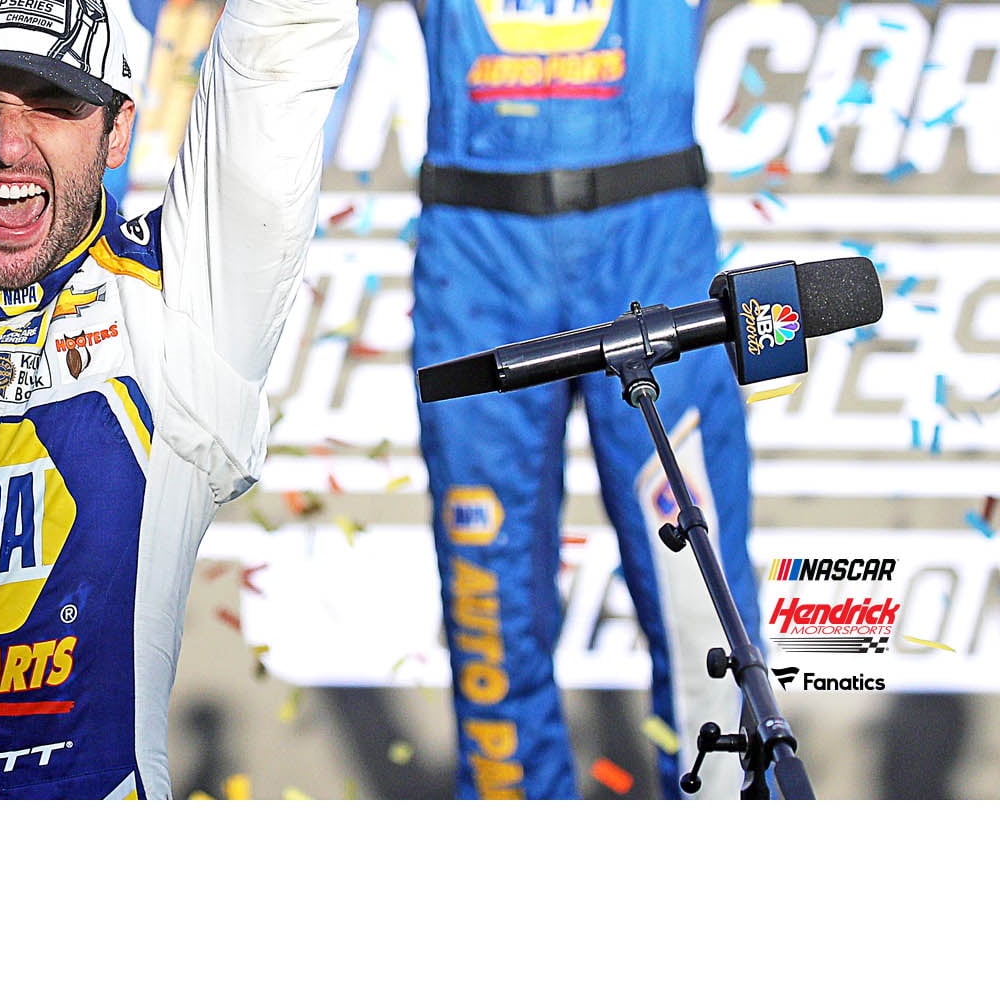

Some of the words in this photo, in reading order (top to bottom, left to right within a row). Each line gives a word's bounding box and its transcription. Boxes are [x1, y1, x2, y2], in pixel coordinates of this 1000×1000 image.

[6, 13, 53, 28] CHAMPION
[3, 285, 37, 305] NAPA
[55, 324, 118, 352] HOOTERS
[740, 299, 762, 355] Sports
[757, 304, 774, 350] NBC
